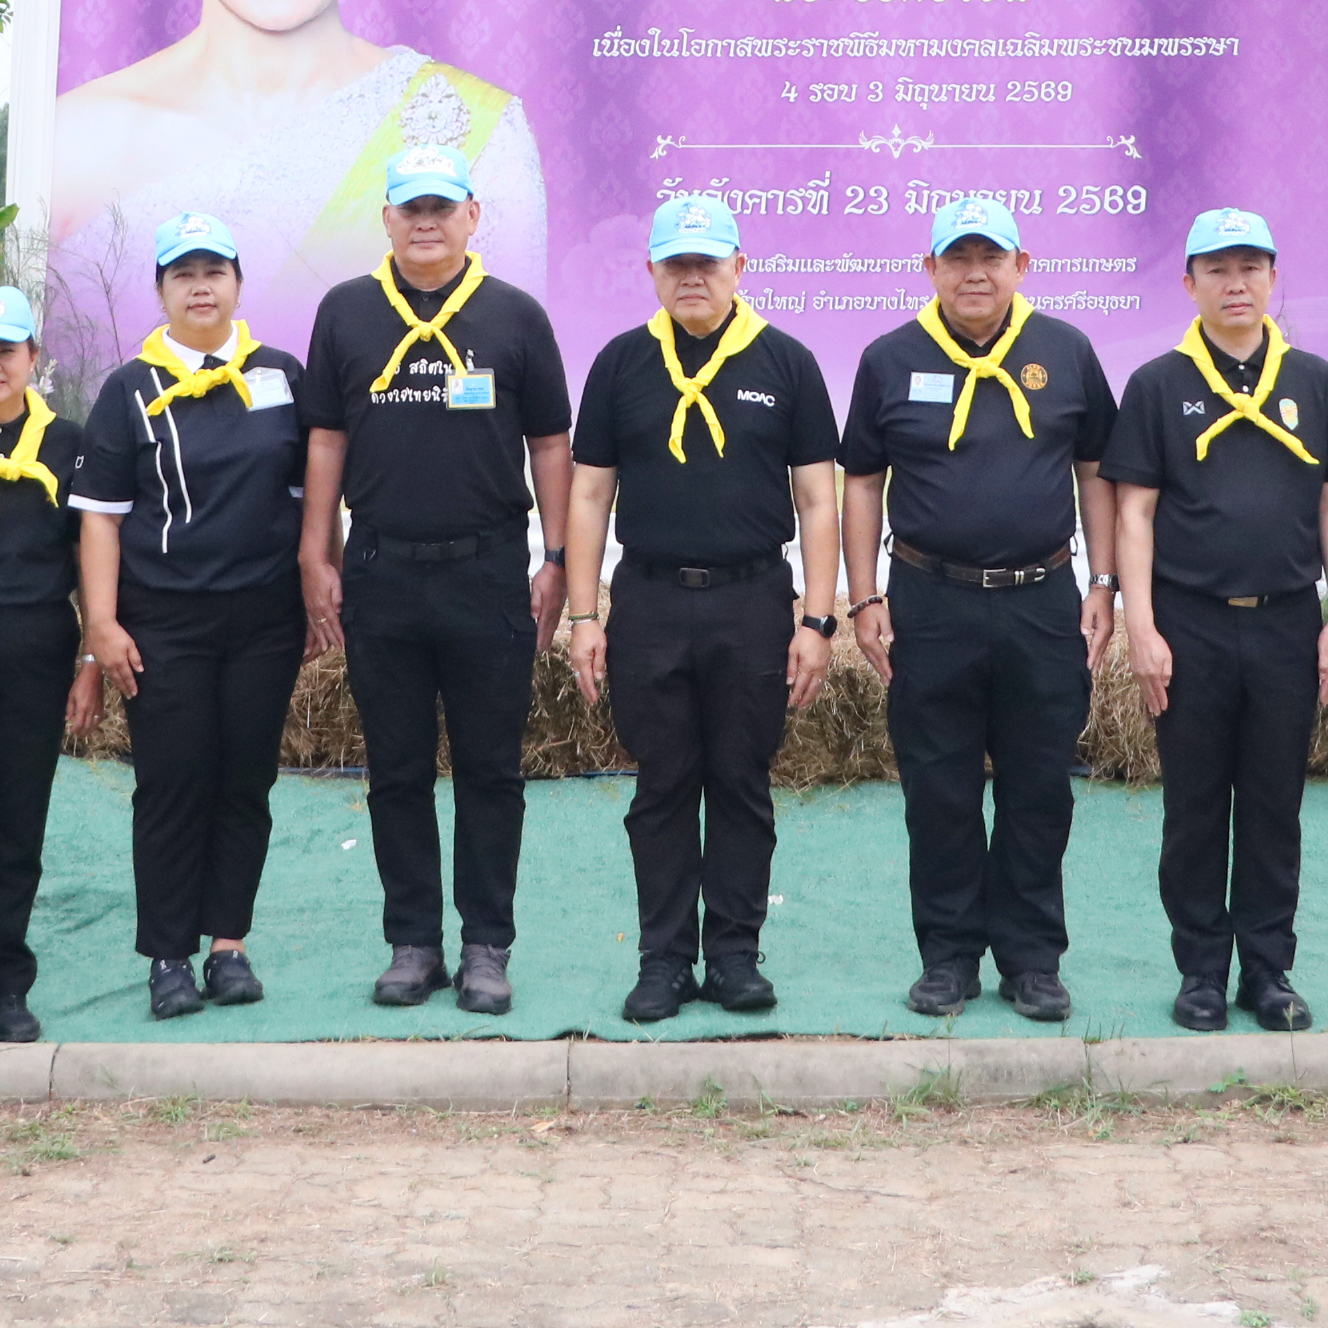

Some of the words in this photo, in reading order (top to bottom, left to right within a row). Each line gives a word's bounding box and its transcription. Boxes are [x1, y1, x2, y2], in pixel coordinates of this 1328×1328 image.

[592, 25, 1240, 58] เนื่องในโอกาสพระราชพิธีมหามงคลเฉลิมพระชนมพรรษา
[780, 81, 799, 103] 4
[809, 81, 857, 103] รอบ
[867, 81, 884, 103] 3
[894, 76, 996, 111] มิถุนายน
[1006, 80, 1073, 103] 2569
[844, 185, 890, 216] 23
[1056, 185, 1148, 216] 2569
[1024, 256, 1138, 273] าคการเกษตร
[736, 388, 776, 407] MOAC
